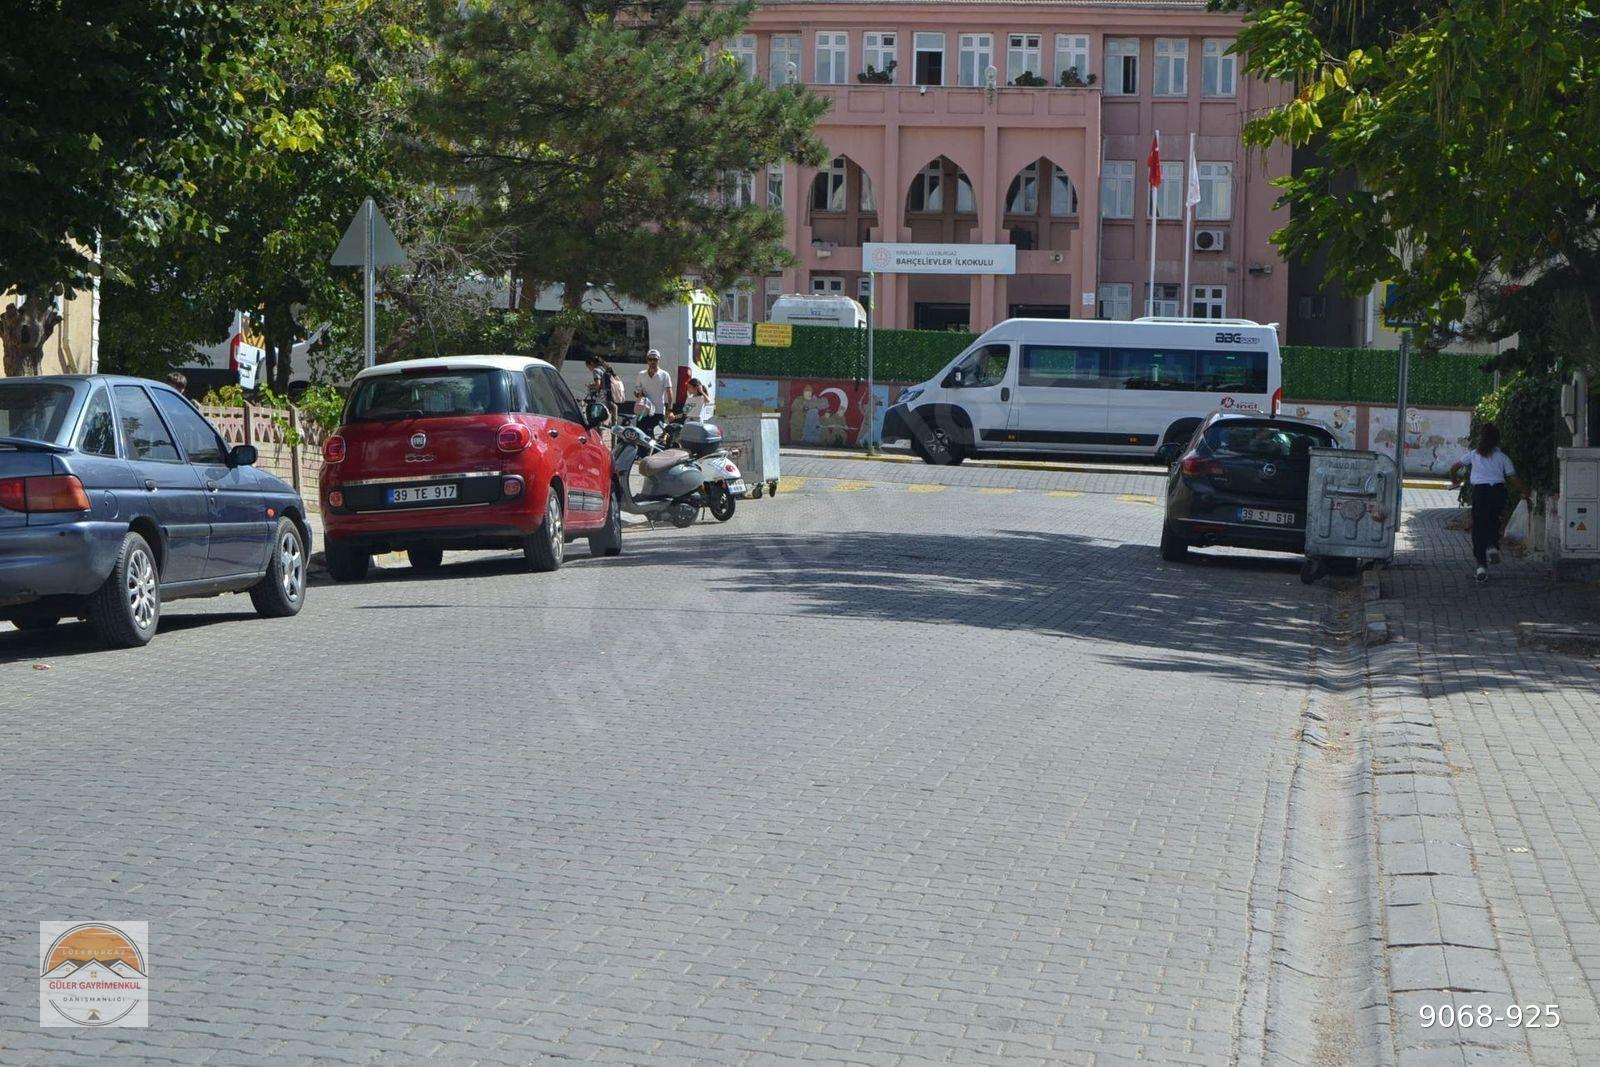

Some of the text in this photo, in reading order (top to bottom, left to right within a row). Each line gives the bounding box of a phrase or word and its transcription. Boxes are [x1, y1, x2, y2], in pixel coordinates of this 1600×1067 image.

[896, 257, 994, 267] BAHÇELİEVLER İLKOKULU
[1215, 332, 1242, 344] BBG
[394, 485, 456, 502] 39 TE 917
[1242, 508, 1254, 519] 39
